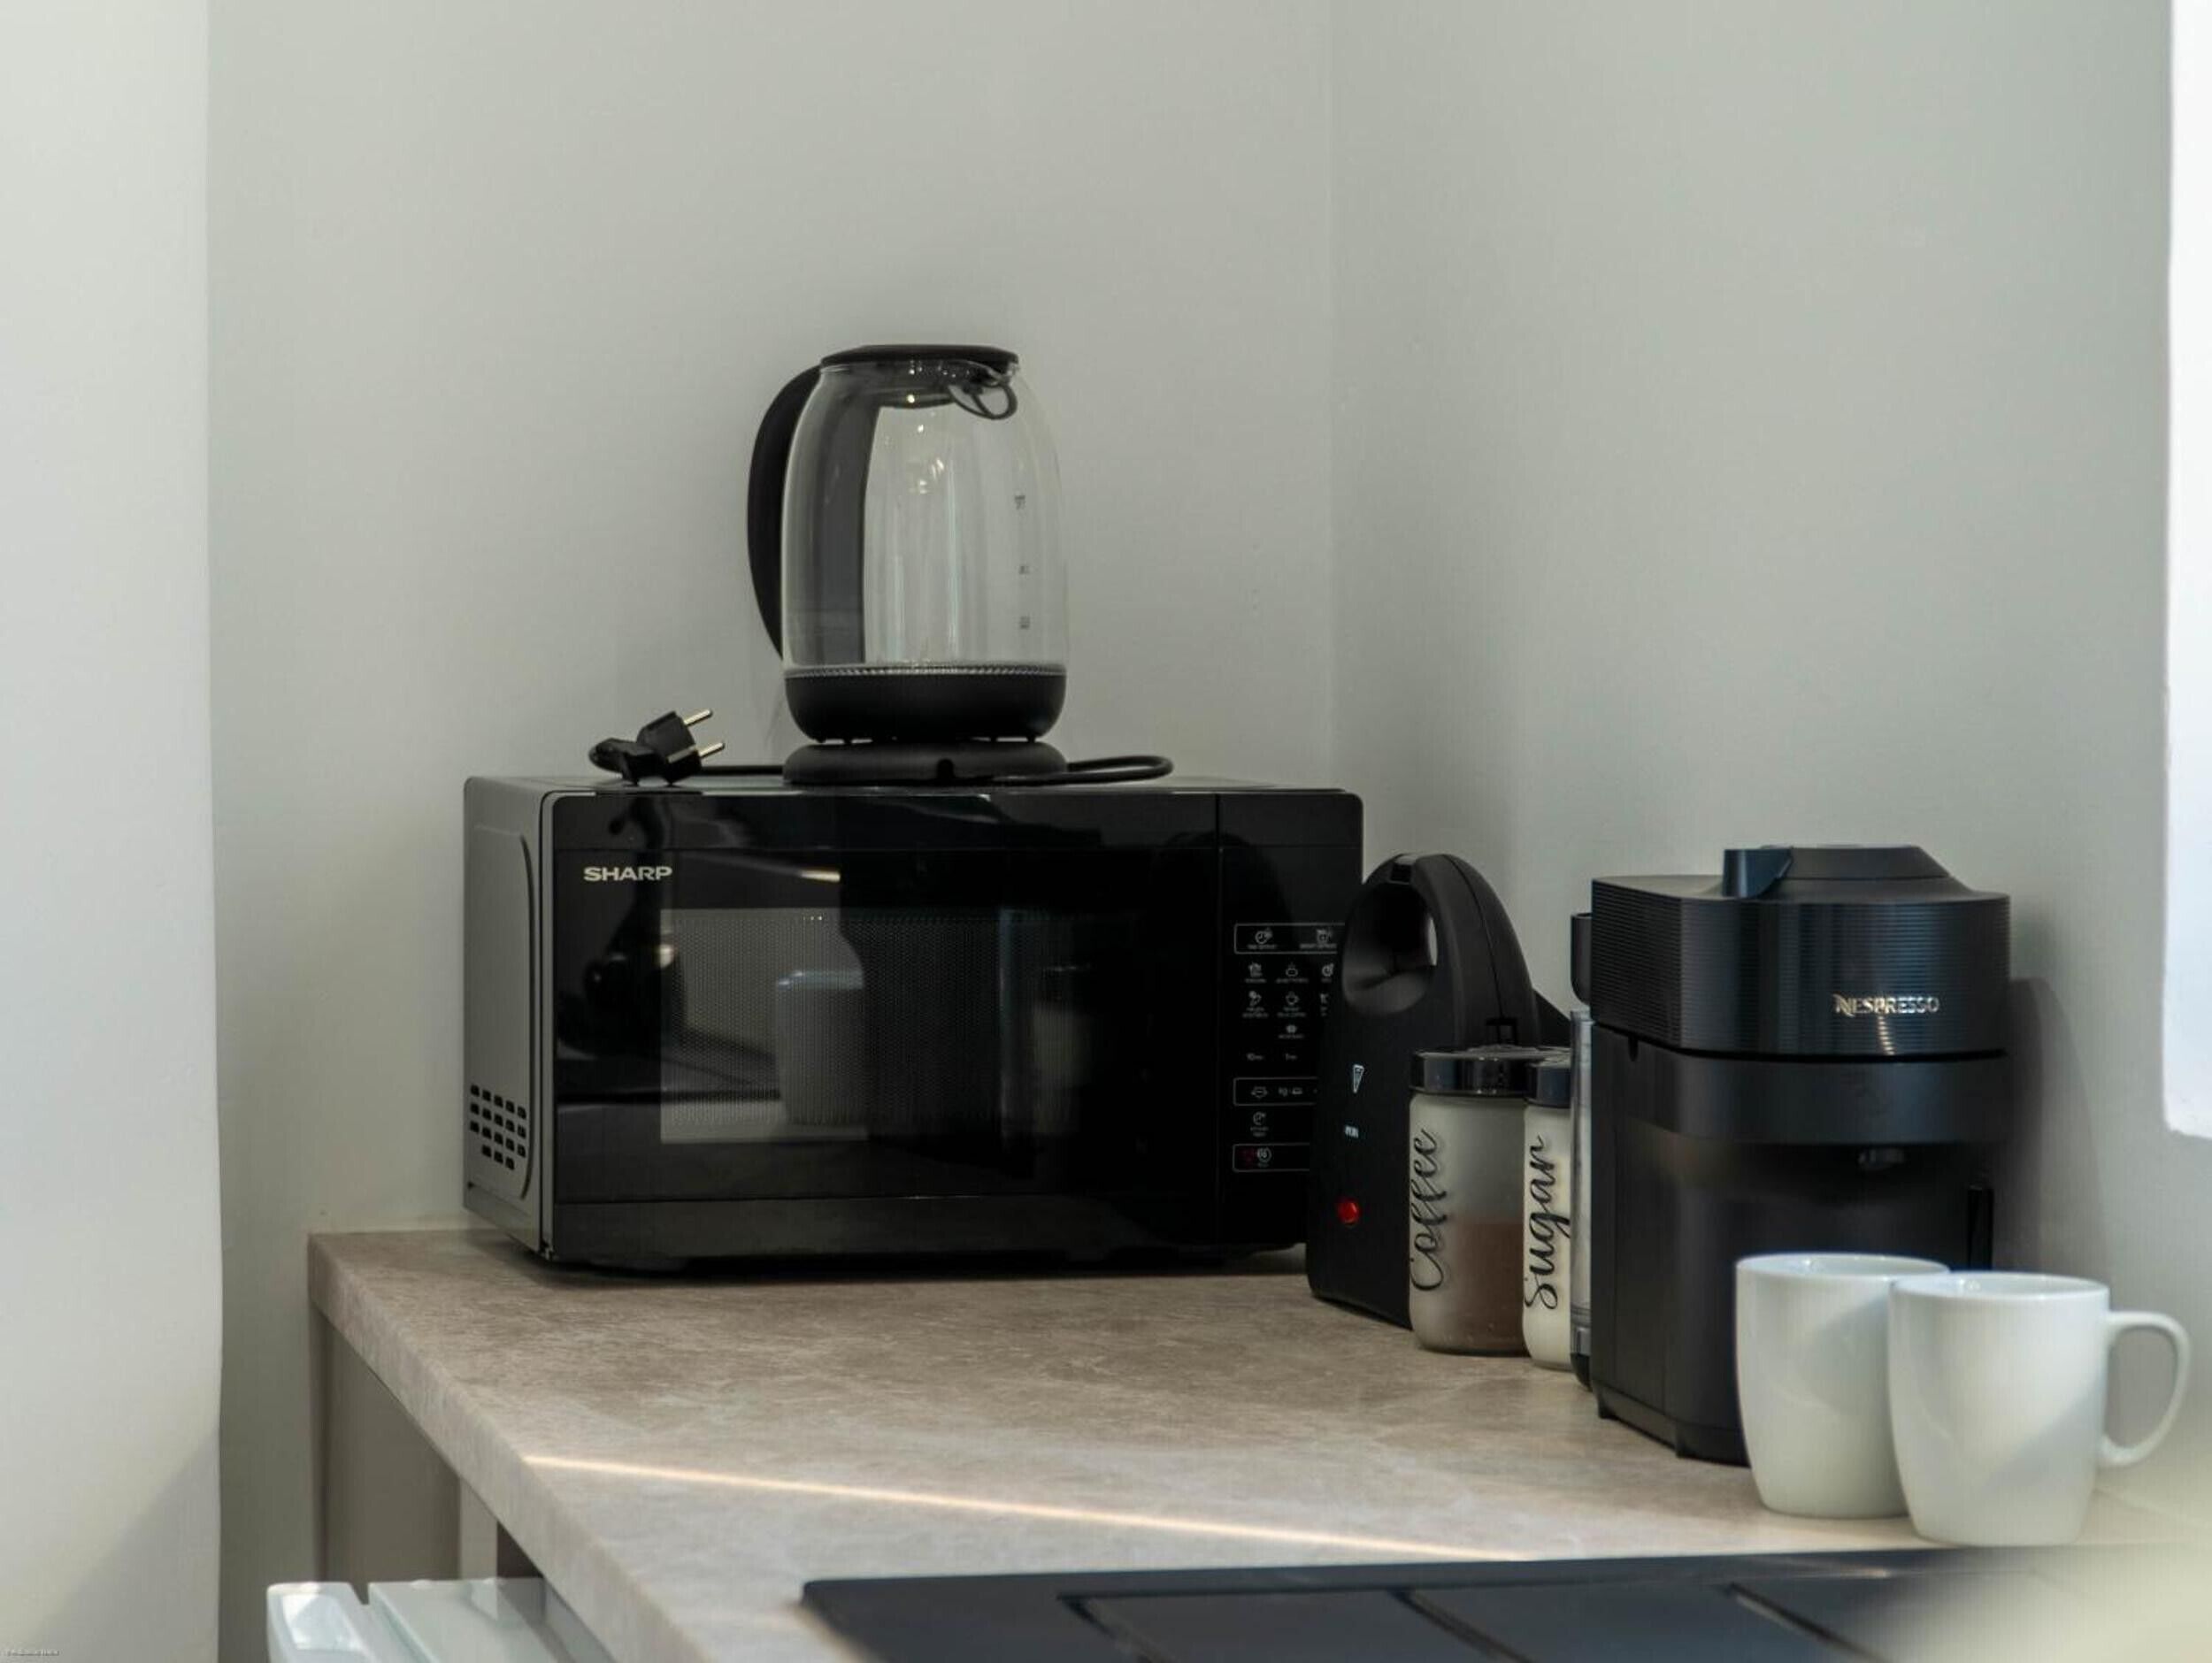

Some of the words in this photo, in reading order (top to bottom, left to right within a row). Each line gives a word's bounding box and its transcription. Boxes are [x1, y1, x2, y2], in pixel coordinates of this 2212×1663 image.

[583, 866, 673, 881] SHARP
[1832, 993, 1940, 1017] NESPRESSO
[1410, 1128, 1449, 1291] Coffee
